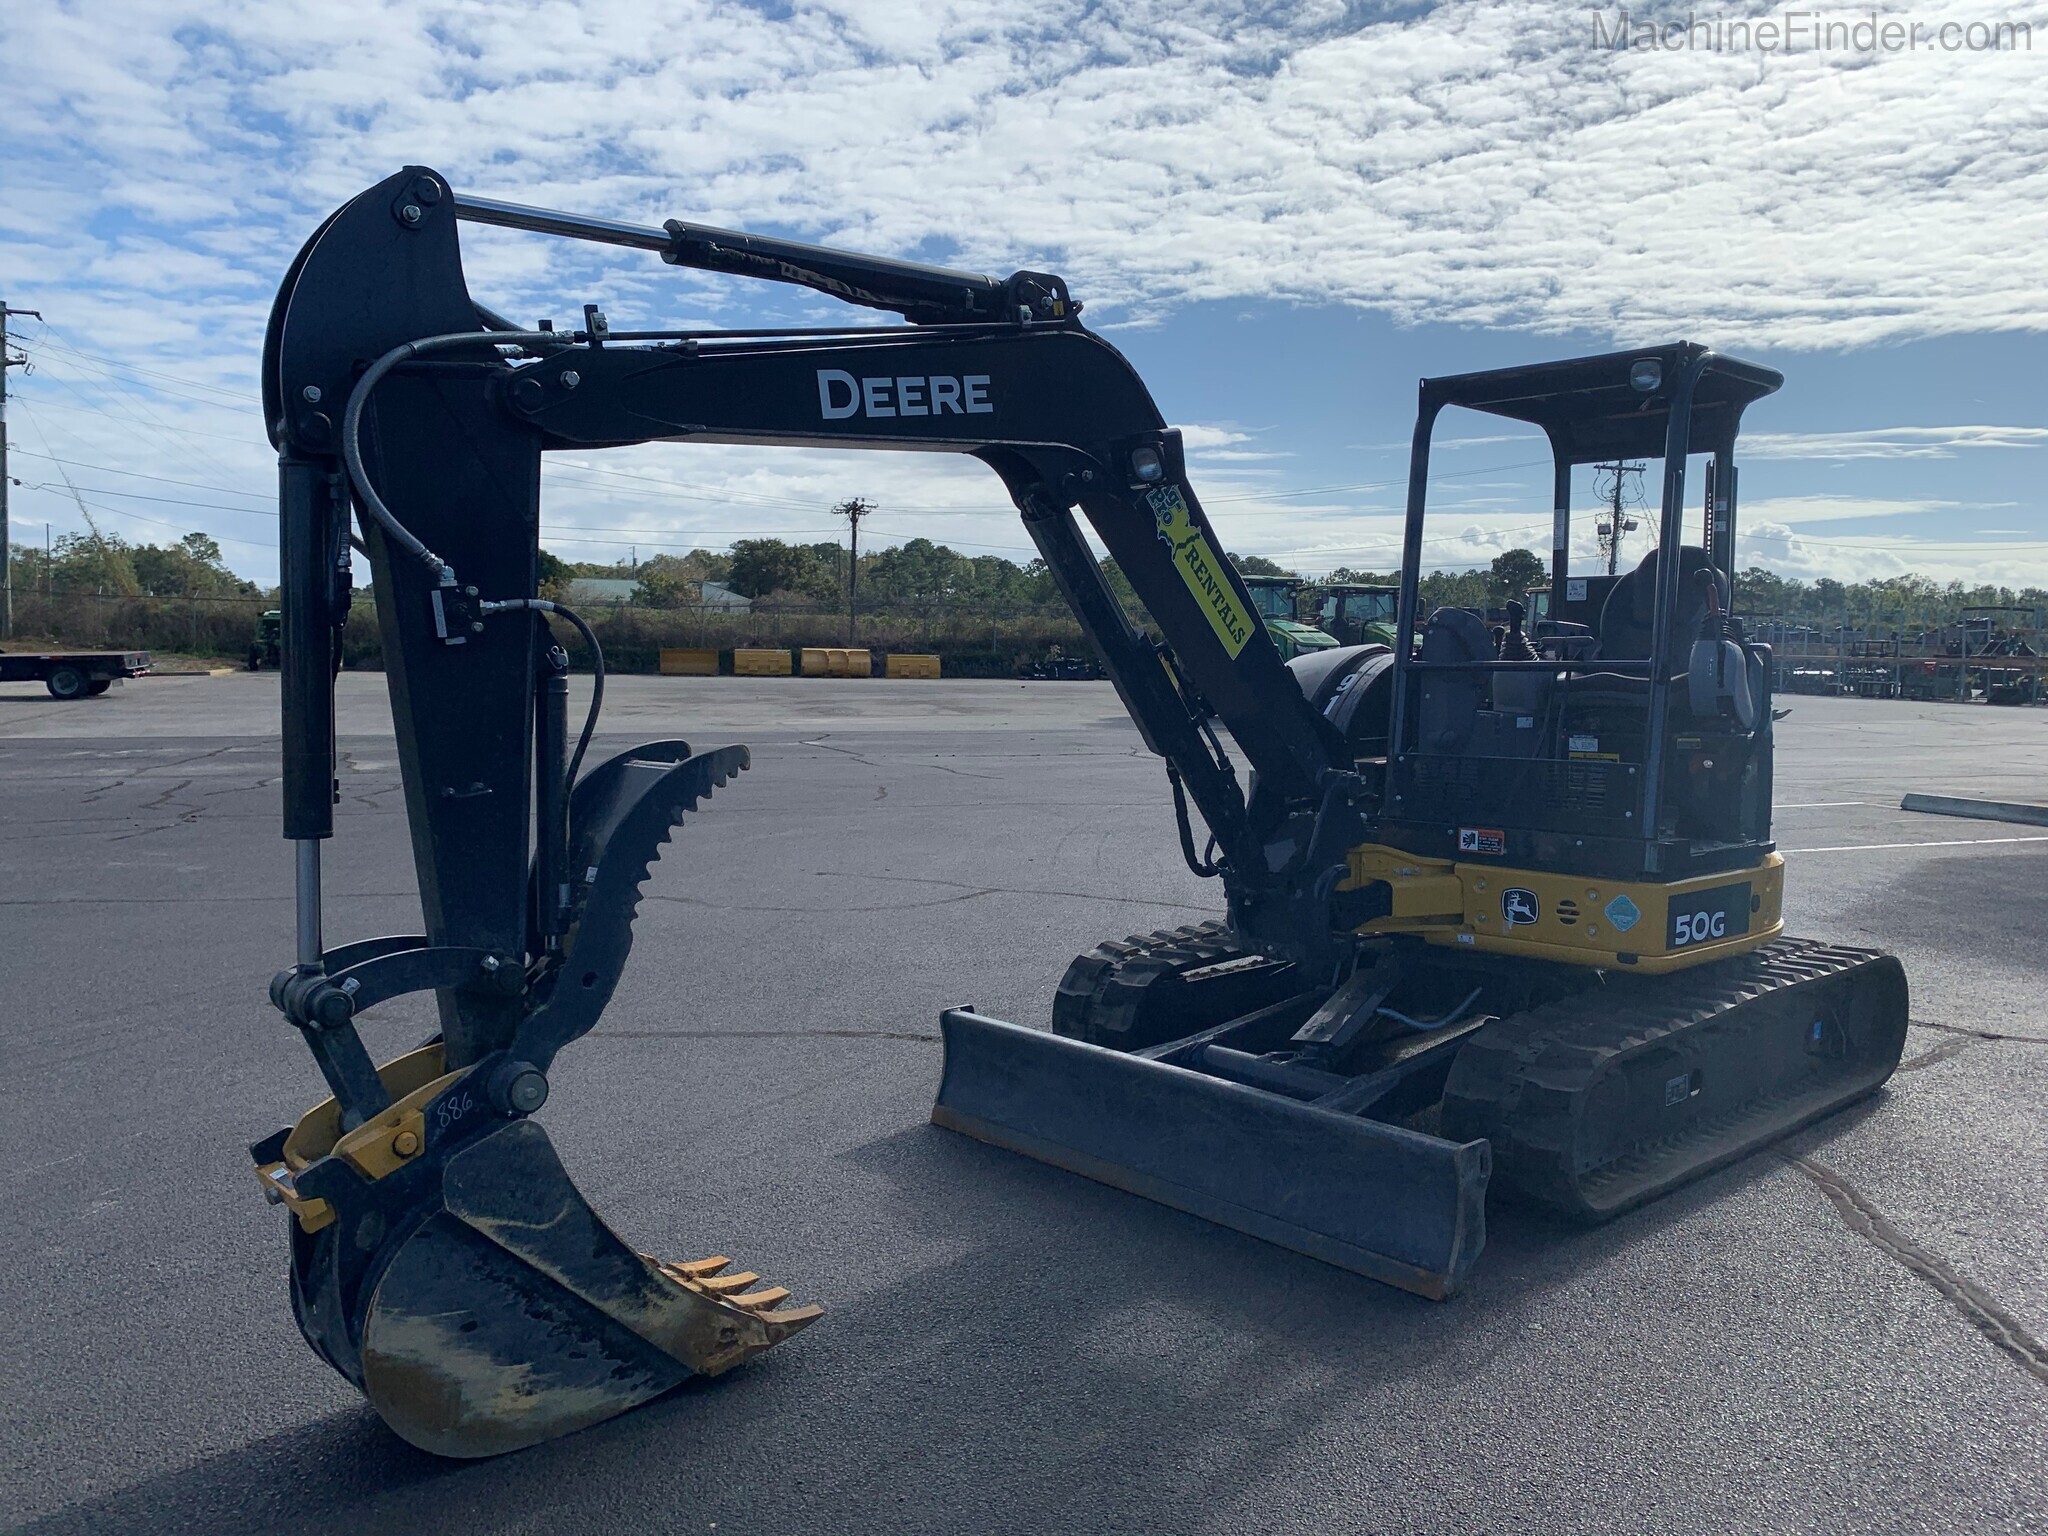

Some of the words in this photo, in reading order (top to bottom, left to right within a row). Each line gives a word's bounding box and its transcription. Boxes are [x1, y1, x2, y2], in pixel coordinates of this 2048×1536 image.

[817, 369, 993, 420] DEERE
[1184, 544, 1246, 645] RENTALS
[1675, 911, 1725, 945] 50G
[437, 1091, 473, 1128] 886
